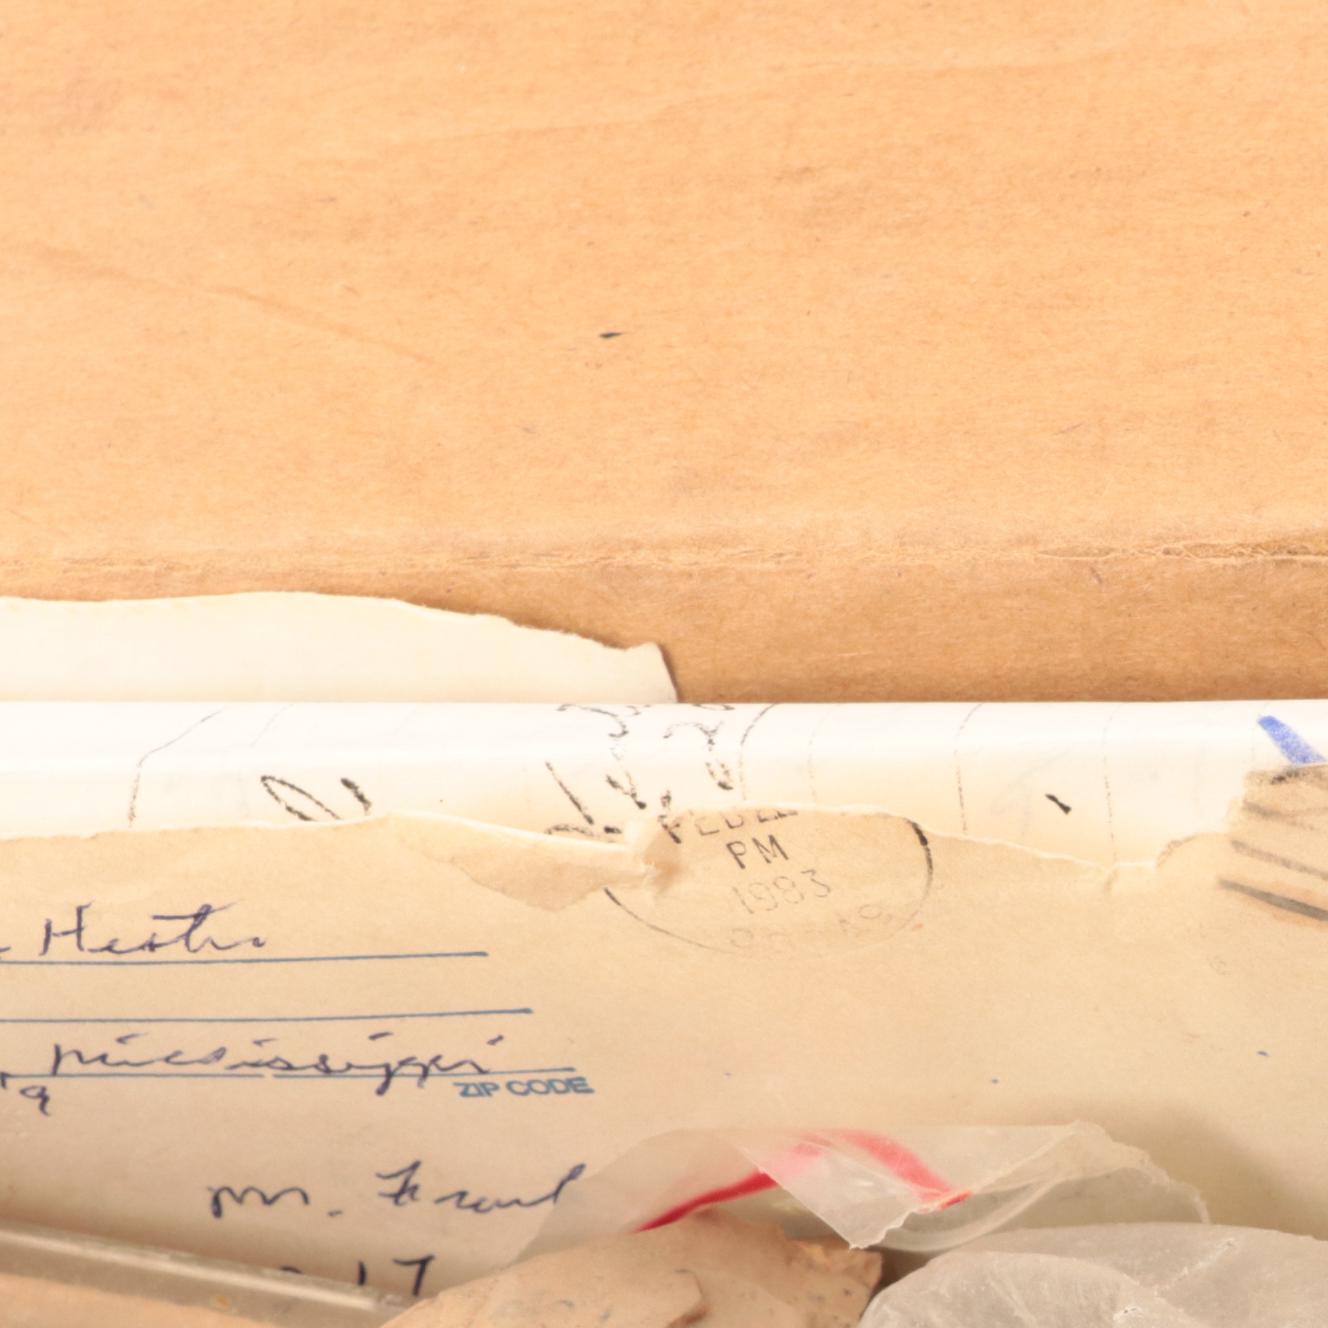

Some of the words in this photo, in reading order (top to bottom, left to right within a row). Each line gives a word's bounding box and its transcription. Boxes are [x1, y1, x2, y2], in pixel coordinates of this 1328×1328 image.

[727, 834, 789, 870] PM
[732, 868, 832, 915] 1983
[454, 1082, 499, 1098] ZIP
[506, 1076, 594, 1098] CODE
